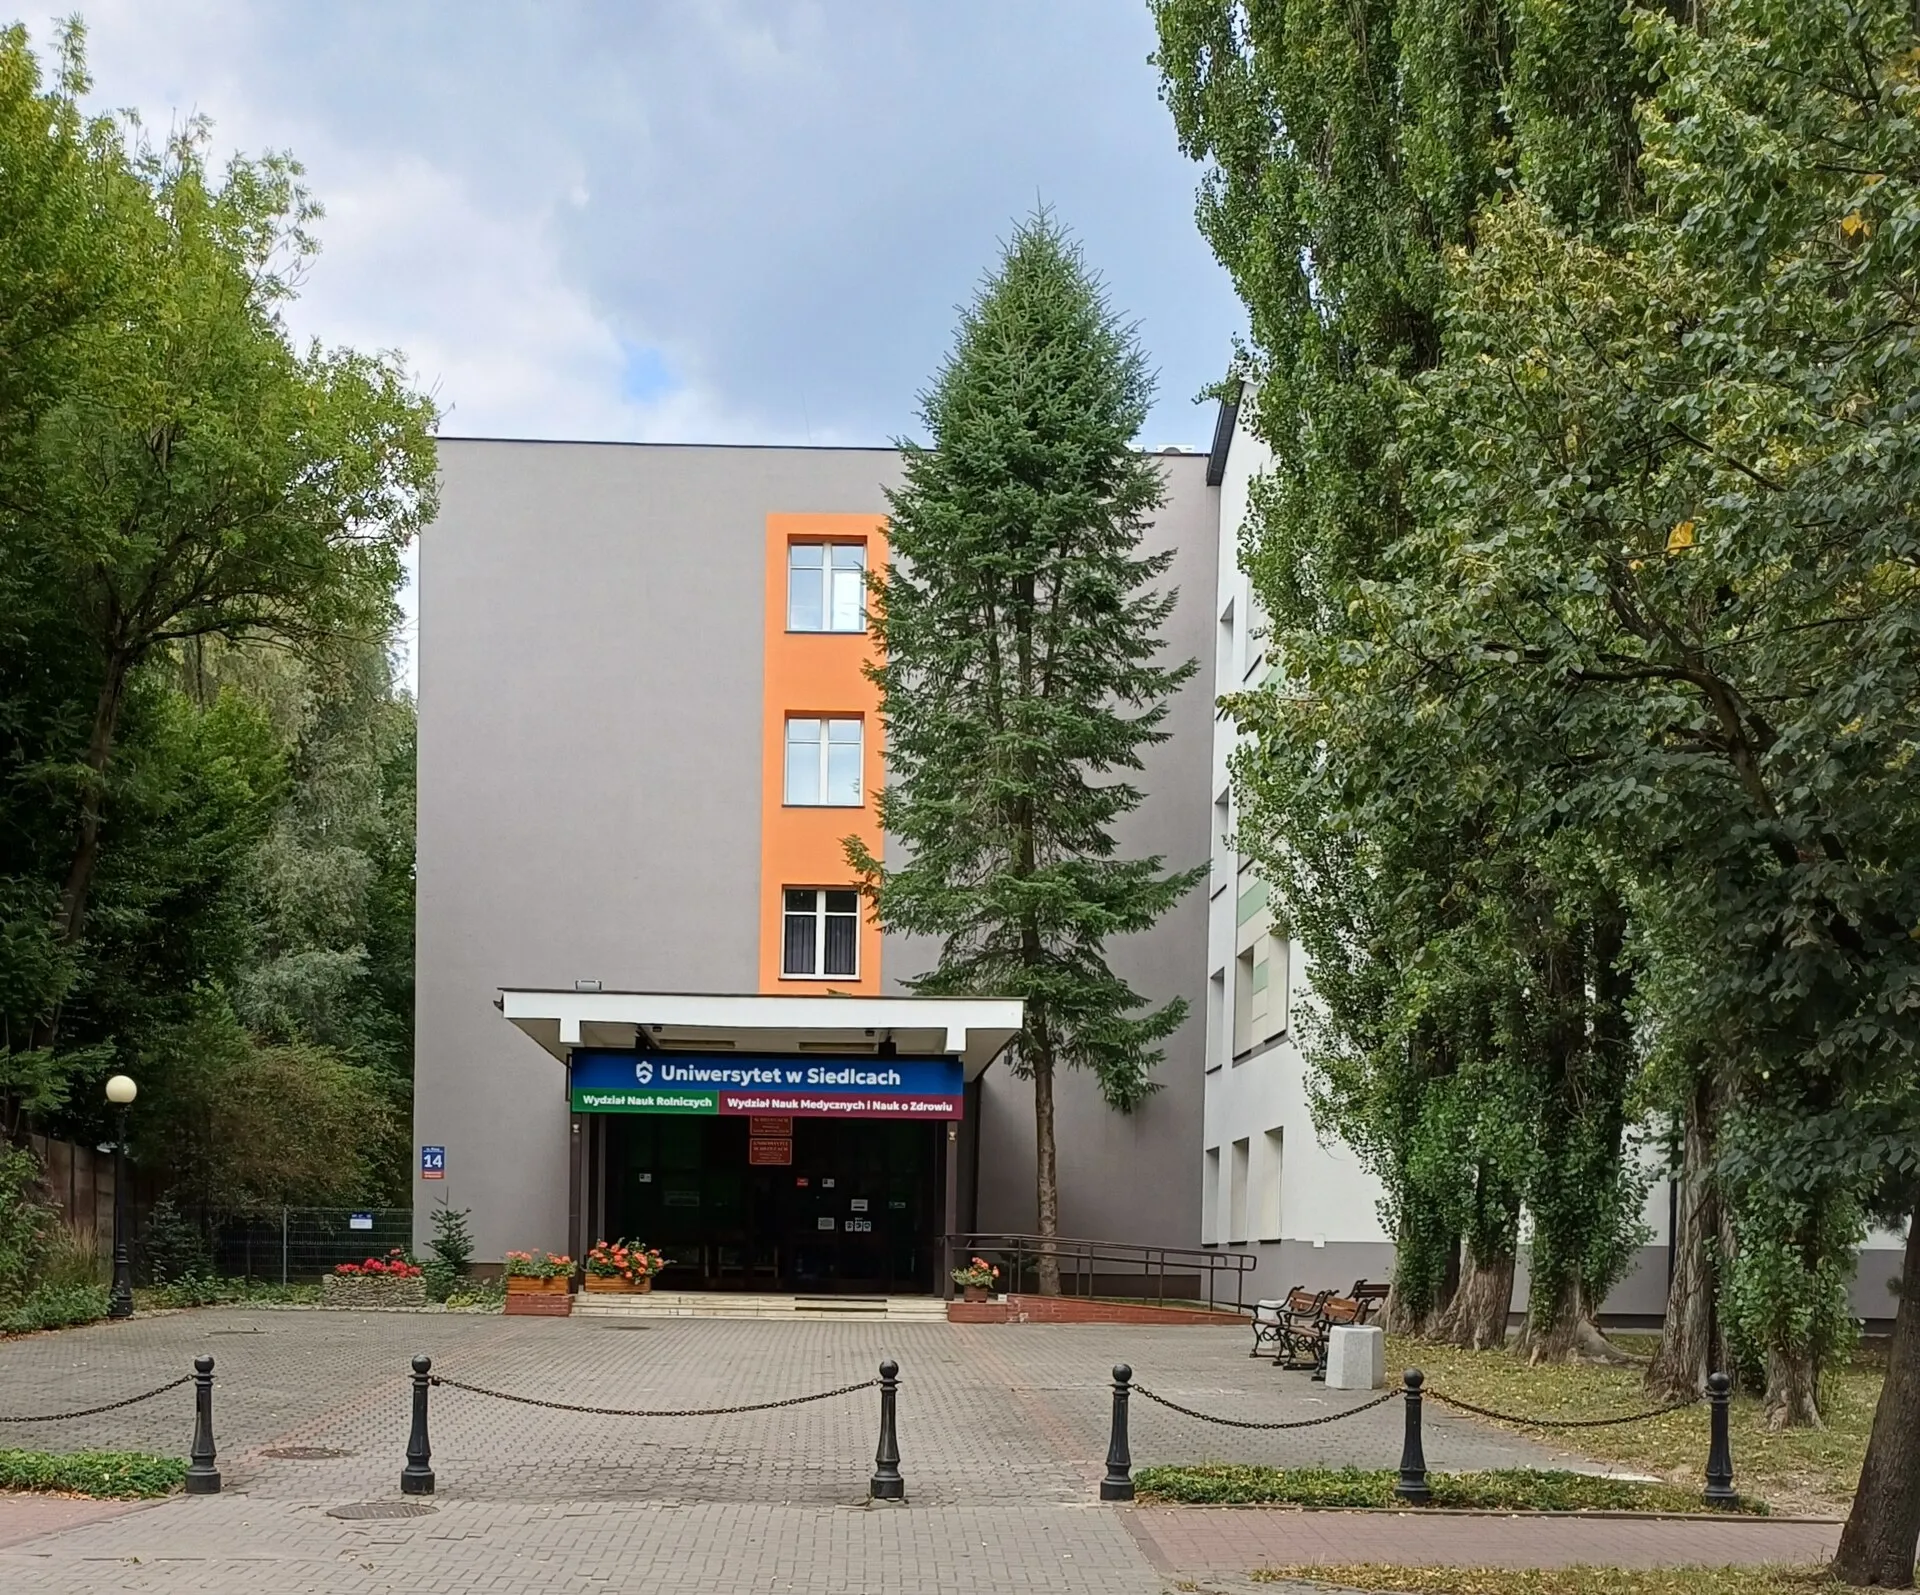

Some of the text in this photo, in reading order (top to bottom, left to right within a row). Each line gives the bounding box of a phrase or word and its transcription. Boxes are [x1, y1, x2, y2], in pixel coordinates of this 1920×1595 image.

[661, 1065, 901, 1086] Uniwersytet w Siedlcach
[583, 1095, 712, 1108] Wydział Nauk Rolniczych
[727, 1098, 953, 1112] Wydział Nauk Medycznych i Nauk o Zdrowiu
[424, 1154, 443, 1168] 14
